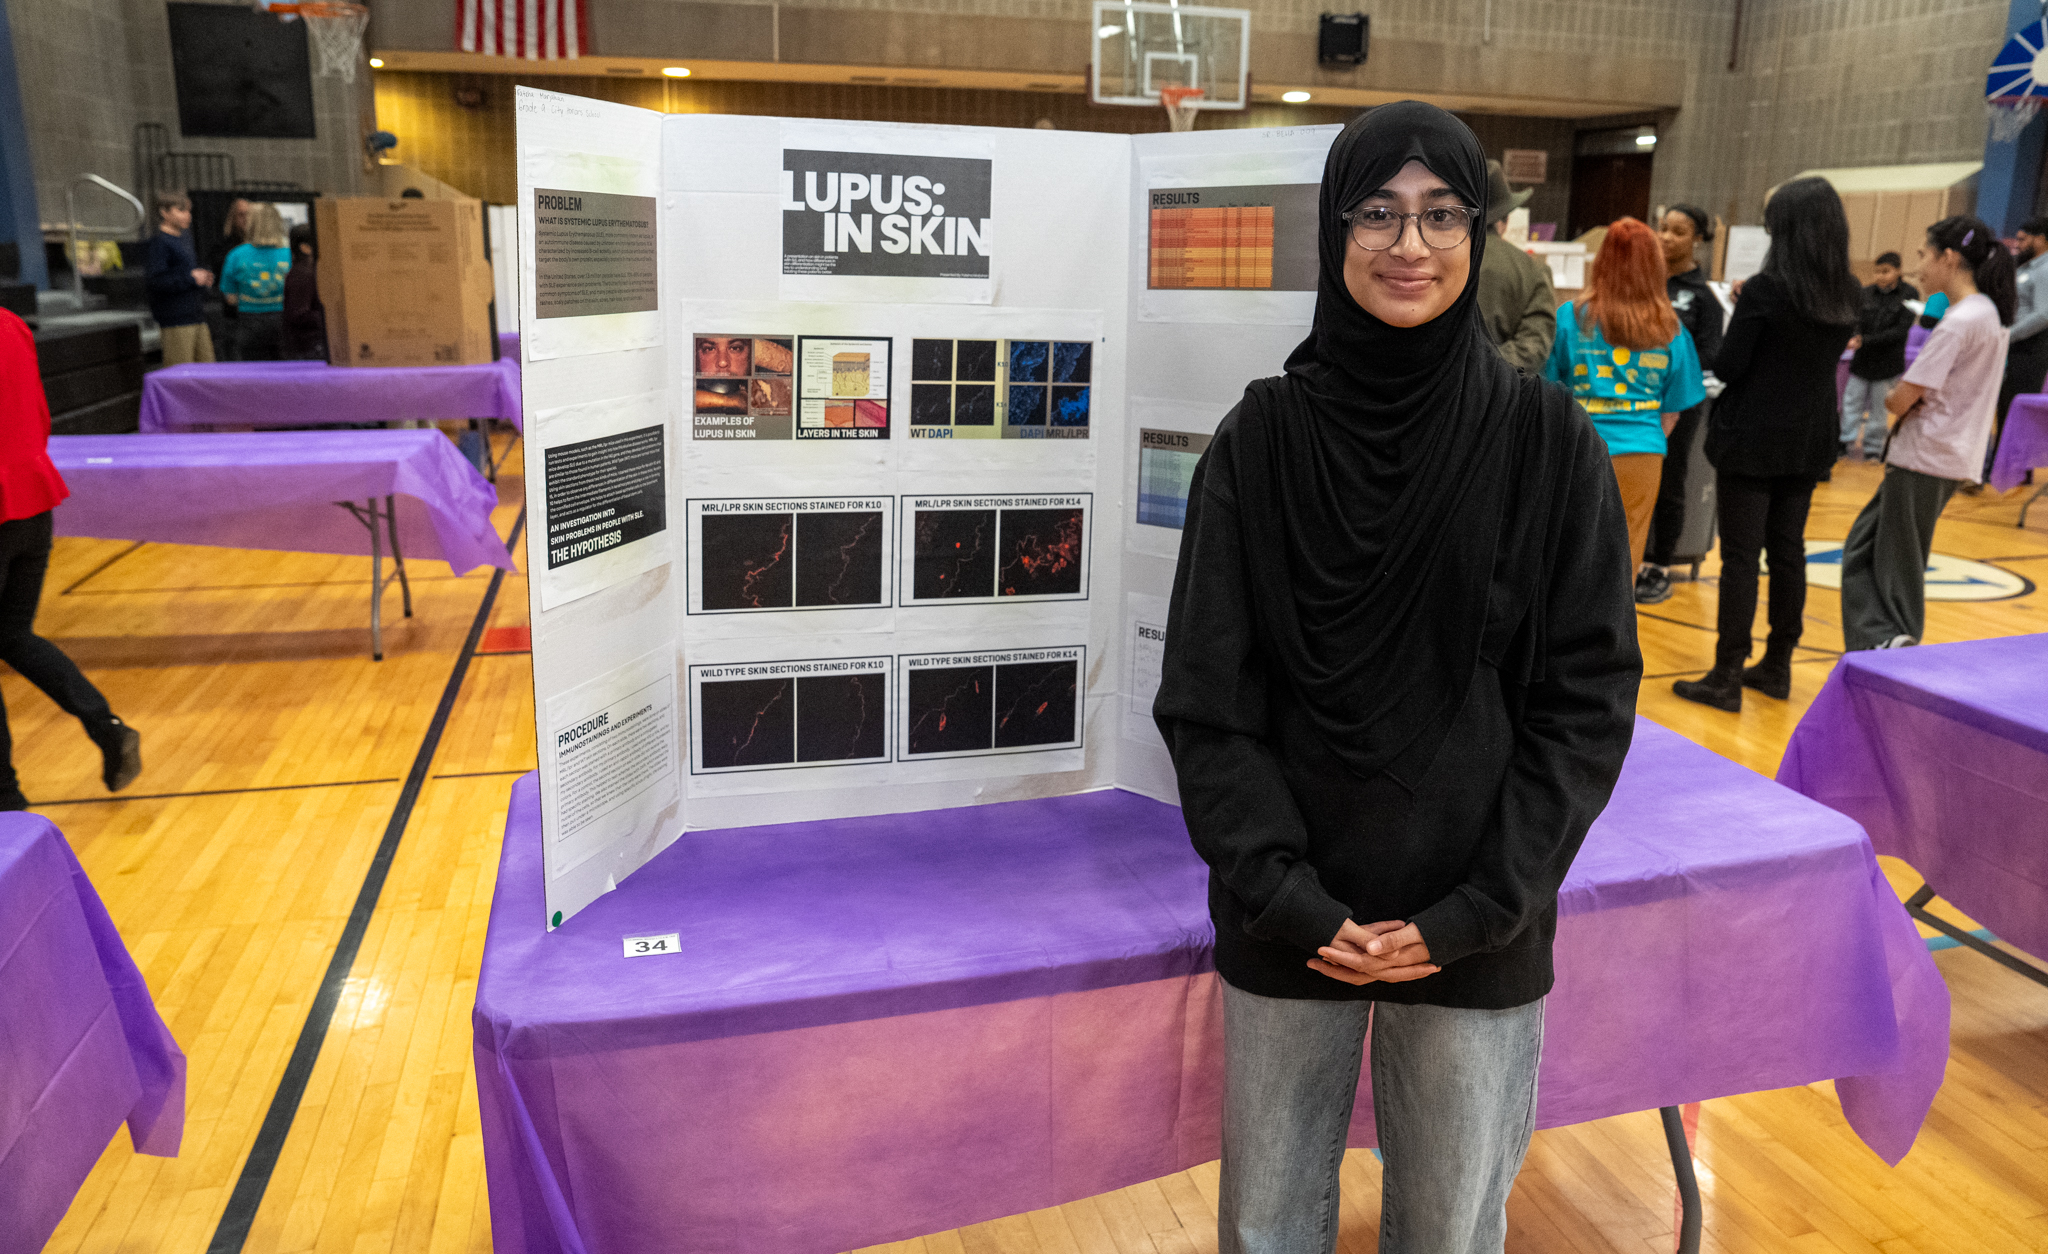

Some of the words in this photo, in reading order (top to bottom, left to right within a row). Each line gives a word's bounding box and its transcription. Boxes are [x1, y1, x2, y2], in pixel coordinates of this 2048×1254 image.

[783, 170, 945, 216] LUPUS:
[1153, 192, 1200, 205] RESULTS
[539, 195, 582, 211] PROBLEM
[539, 217, 556, 225] WHAT
[609, 220, 648, 228] ERYTHEMATOSUS?
[824, 212, 872, 253] IN
[880, 214, 990, 256] SKIN
[695, 417, 741, 425] EXAMPLES
[743, 417, 754, 425] OF
[695, 430, 723, 438] LUPUS
[911, 429, 926, 438] WT
[929, 429, 952, 438] DAPI
[1020, 429, 1044, 438] DAPI
[1046, 429, 1088, 439] MRL/LPR
[1143, 432, 1188, 446] RESULTS
[702, 503, 741, 511] MRL/LPR
[916, 499, 951, 508] MRL/LPR
[974, 499, 1013, 507] SECTIONS
[1015, 498, 1047, 506] STAINED
[550, 523, 559, 533] AN
[560, 512, 601, 530] INVESTIGATION
[603, 508, 615, 518] INTO
[551, 535, 565, 545] SKIN
[566, 528, 595, 542] PROBLEMS
[602, 519, 621, 530] PEOPLE
[622, 514, 634, 524] WITH
[635, 510, 644, 520] SLE.
[552, 548, 569, 563] THE
[571, 530, 621, 558] HYPOTHESIS
[1139, 627, 1165, 641] RESU
[909, 659, 929, 667] WILD
[973, 654, 1011, 663] SECTIONS
[1013, 652, 1045, 661] STAINED
[701, 669, 723, 678] WILD
[725, 668, 746, 676] TYPE
[748, 667, 768, 675] SKIN
[770, 664, 811, 674] SECTIONS
[813, 663, 848, 672] STAINED
[850, 662, 866, 670] FOR
[868, 661, 883, 669] K10
[558, 712, 609, 747] PROCEDURE
[559, 728, 610, 758] IMMUNOSTAININGS
[611, 722, 622, 732] AND
[622, 704, 652, 727] EXPERIMENTS
[635, 940, 668, 952] 34
